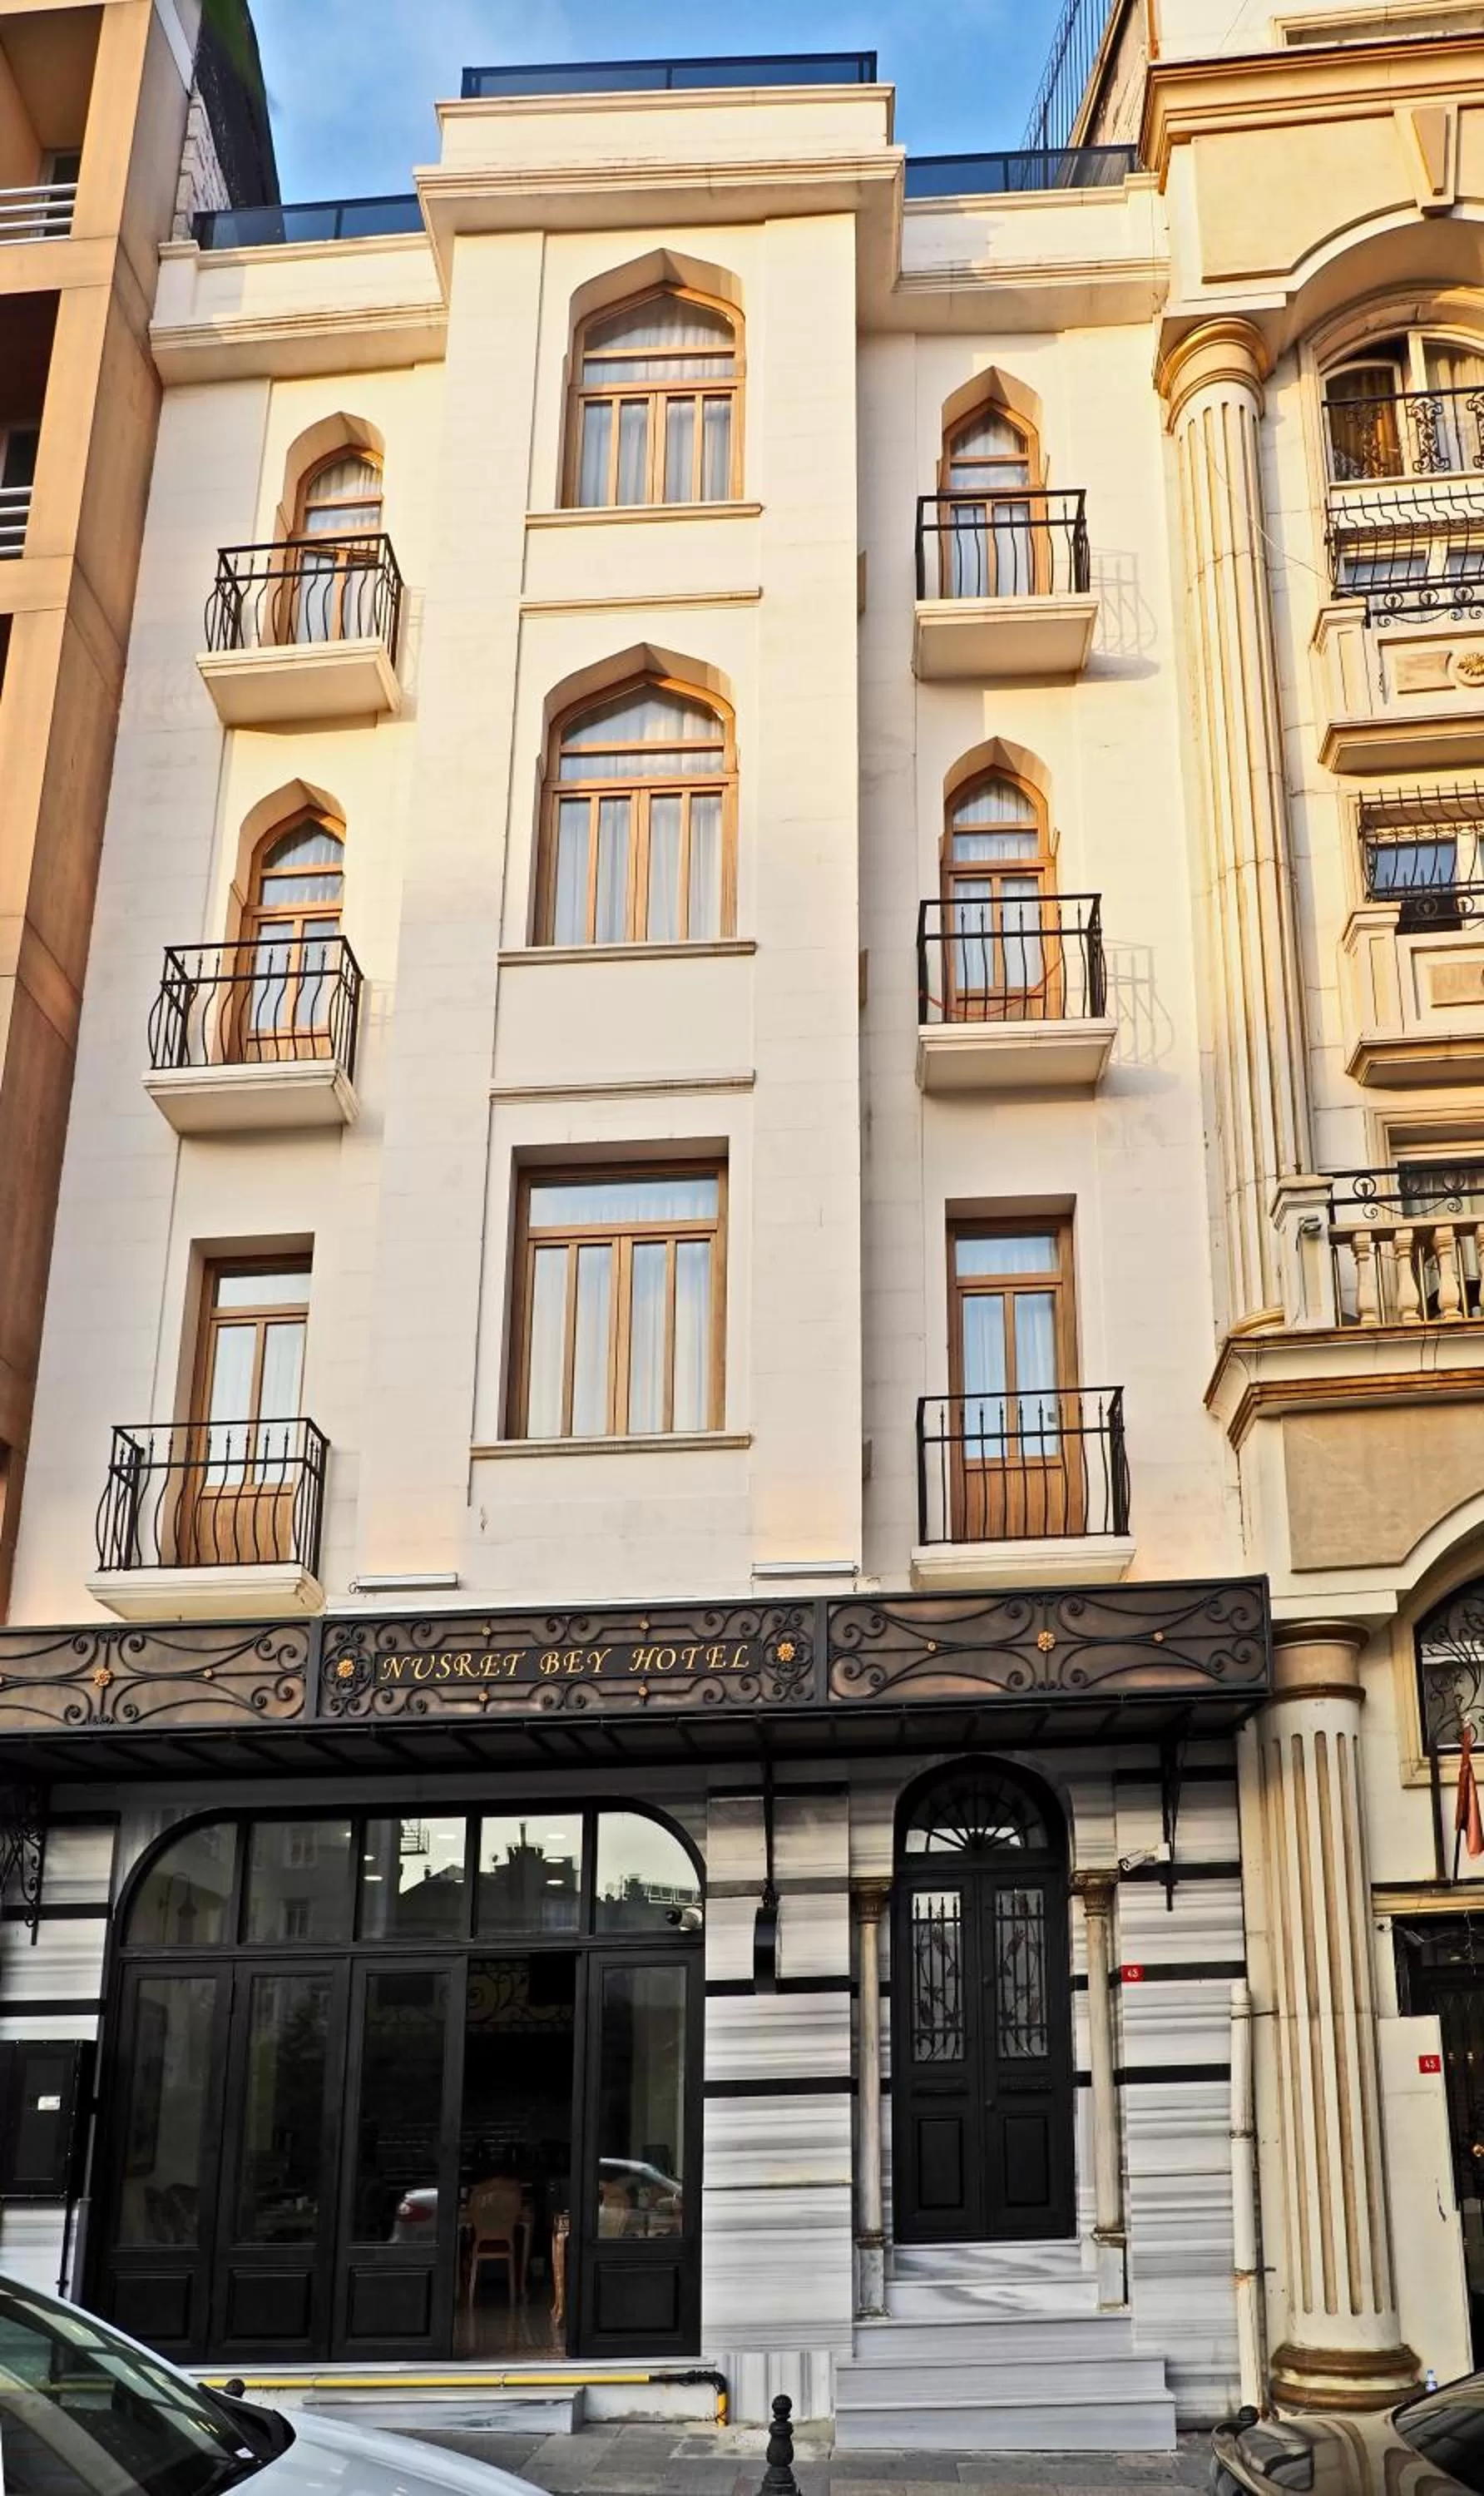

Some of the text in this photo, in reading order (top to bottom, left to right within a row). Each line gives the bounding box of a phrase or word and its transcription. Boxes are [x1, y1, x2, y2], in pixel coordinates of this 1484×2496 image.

[379, 1644, 749, 1681] NUSRET BEY HOTEL
